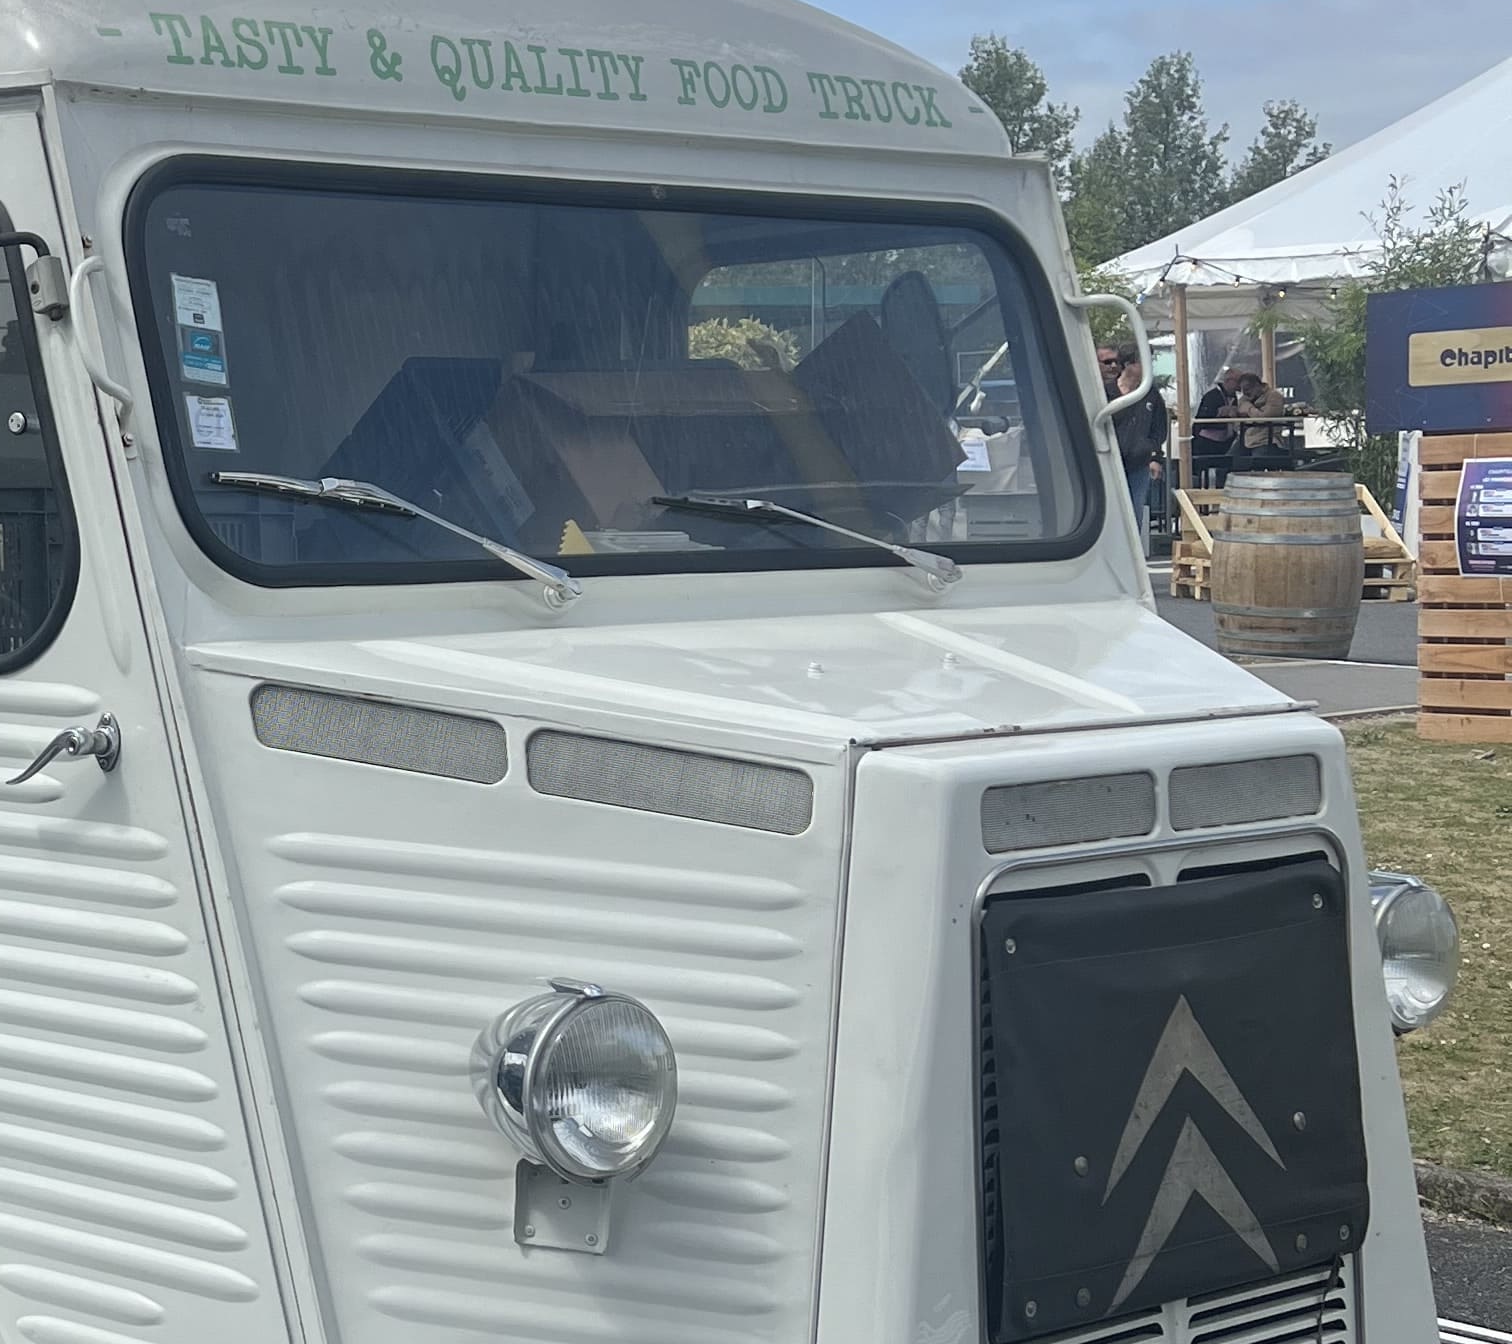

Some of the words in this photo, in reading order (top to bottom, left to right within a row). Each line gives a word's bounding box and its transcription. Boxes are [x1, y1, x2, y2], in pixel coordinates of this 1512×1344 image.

[148, 11, 336, 76] TASTY
[366, 28, 402, 82] &
[430, 34, 648, 102] QUALITY
[676, 59, 788, 114] FOOD
[807, 71, 953, 128] TRUCK
